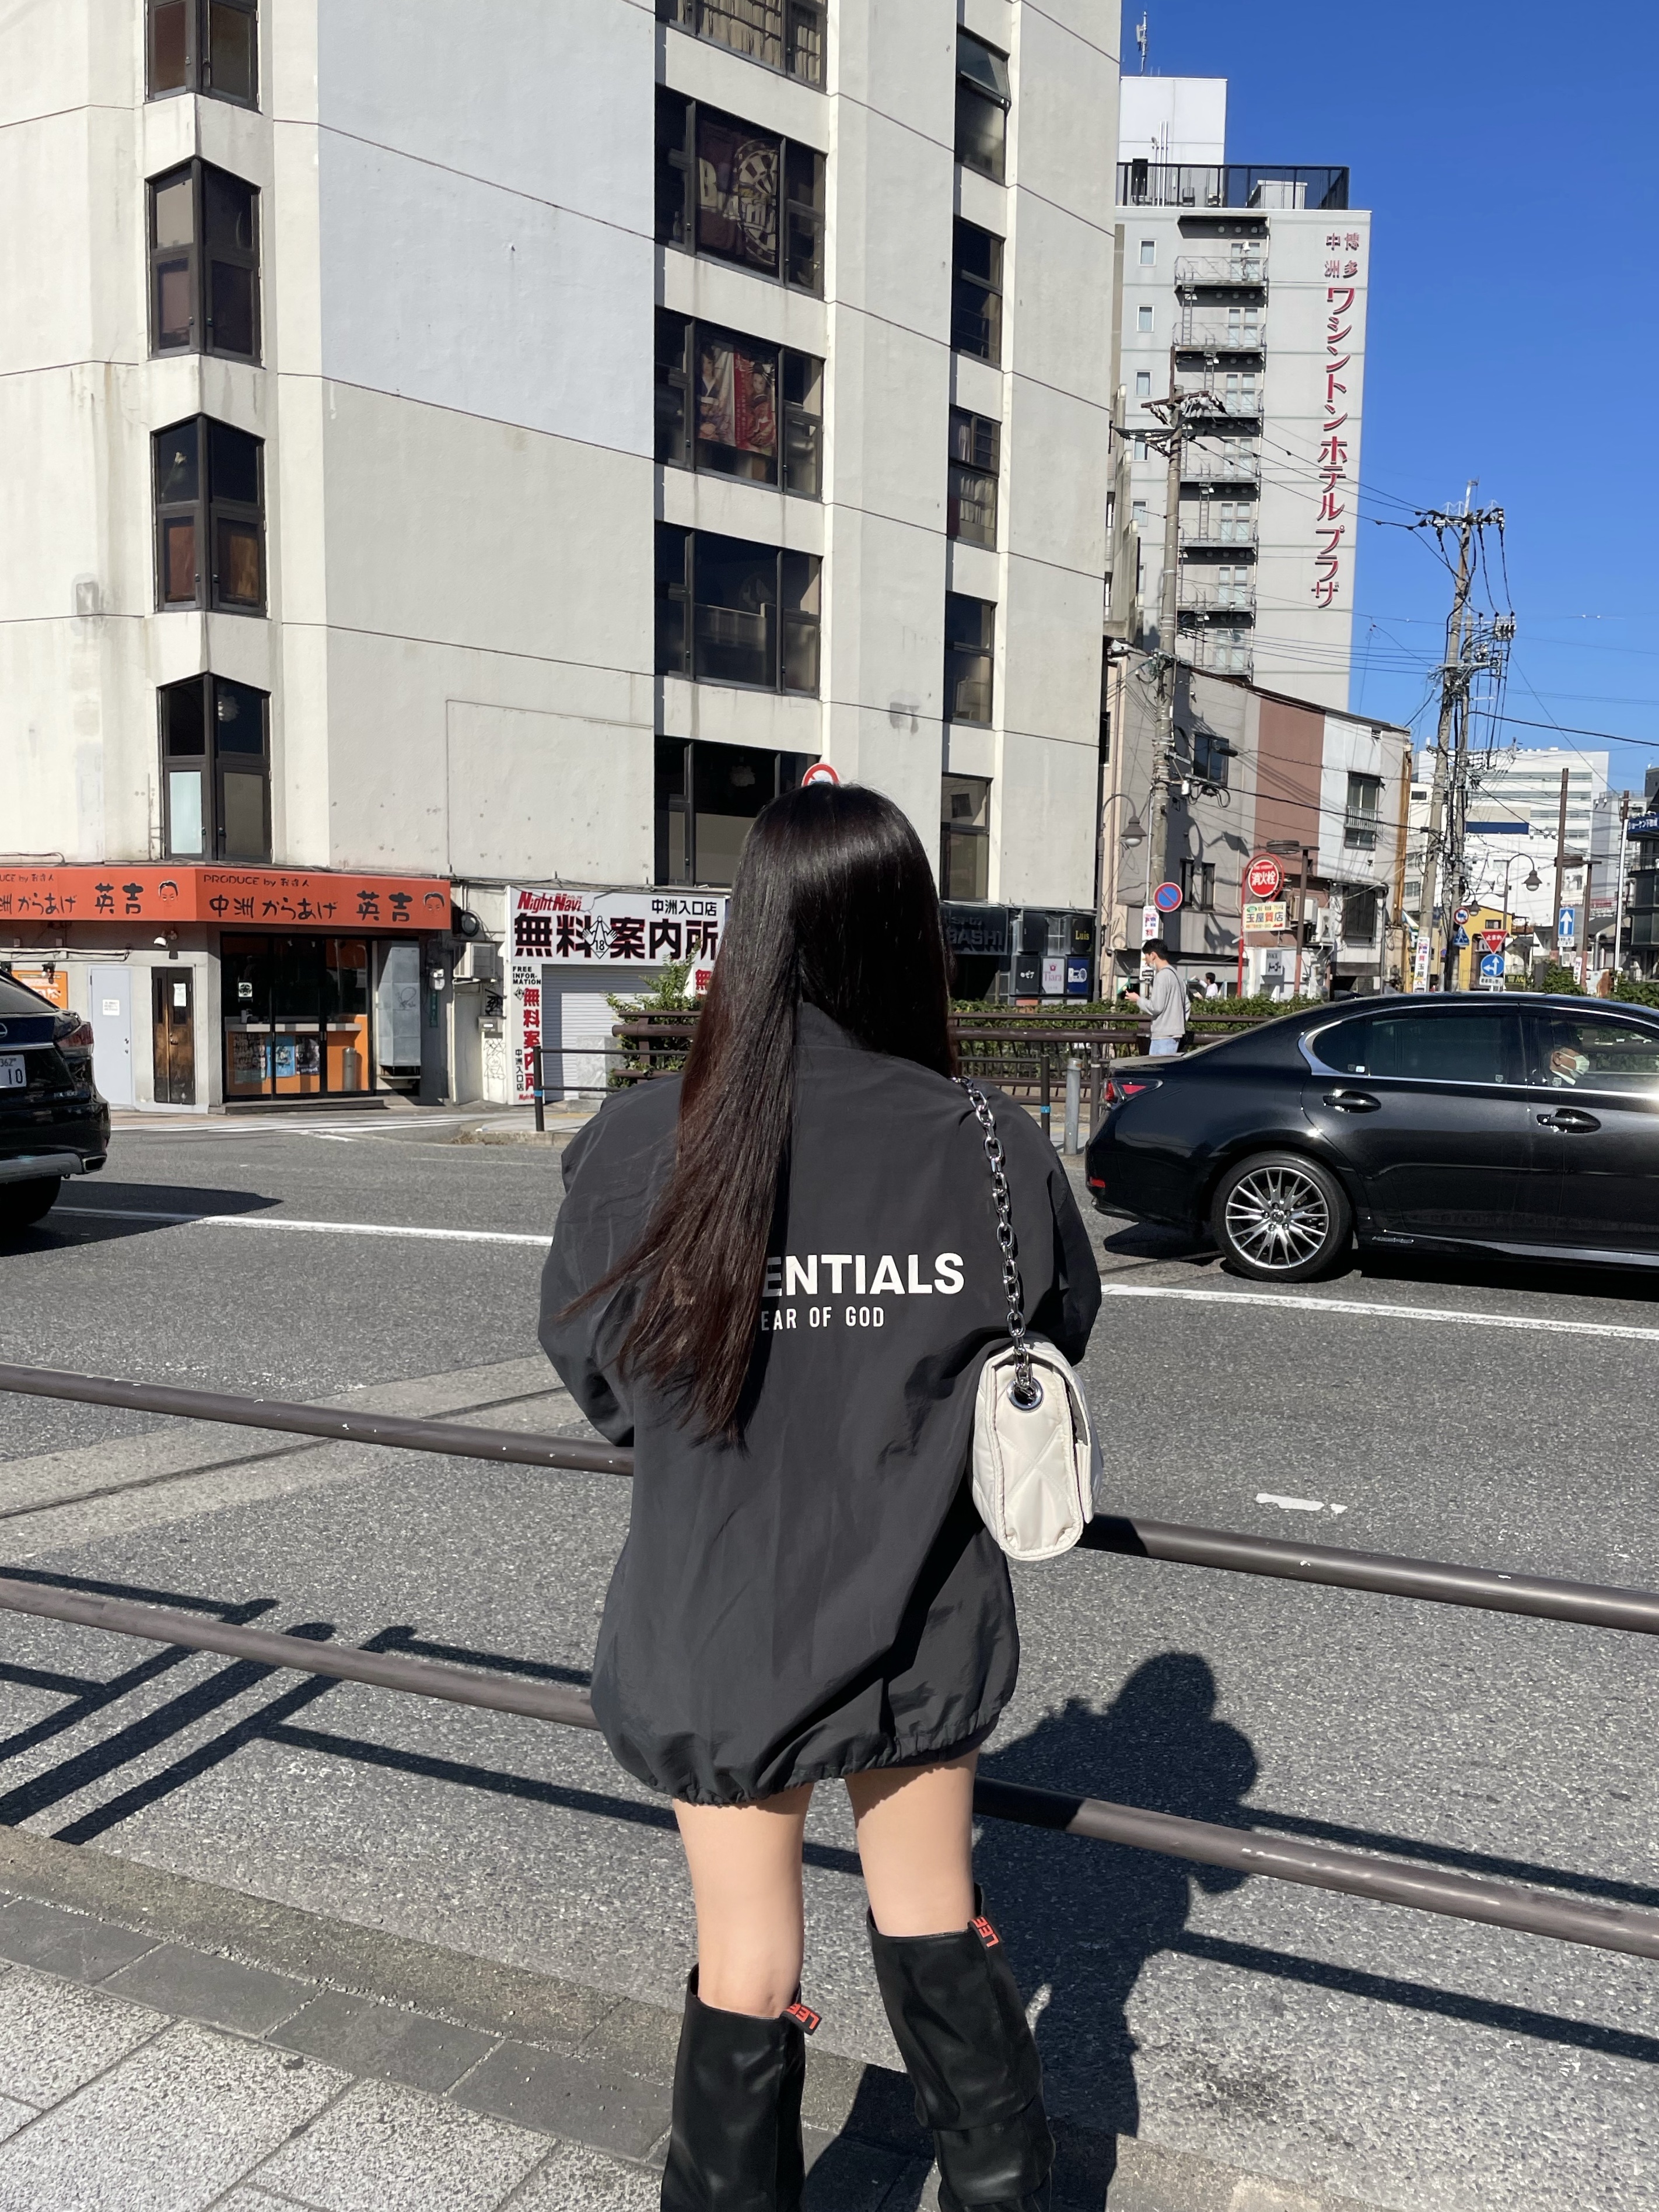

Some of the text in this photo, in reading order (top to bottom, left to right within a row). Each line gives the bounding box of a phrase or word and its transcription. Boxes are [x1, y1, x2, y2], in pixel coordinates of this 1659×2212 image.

[1324, 232, 1340, 278] 中洲
[1344, 232, 1359, 279] 博多
[1311, 288, 1355, 609] ワシントンホテルプラザ
[204, 875, 260, 885] PRODUCE
[264, 878, 276, 887] by
[1251, 871, 1276, 886] 消火栓
[94, 882, 144, 914] 英吉
[356, 890, 413, 922] 英吉
[652, 899, 718, 916] 中洲入口店
[594, 939, 605, 951] 18
[1075, 930, 1090, 941] Luis
[1043, 970, 1062, 982] Tiara
[762, 1252, 964, 1297] ENTIALS
[761, 1306, 884, 1331] EAR OF GOD
